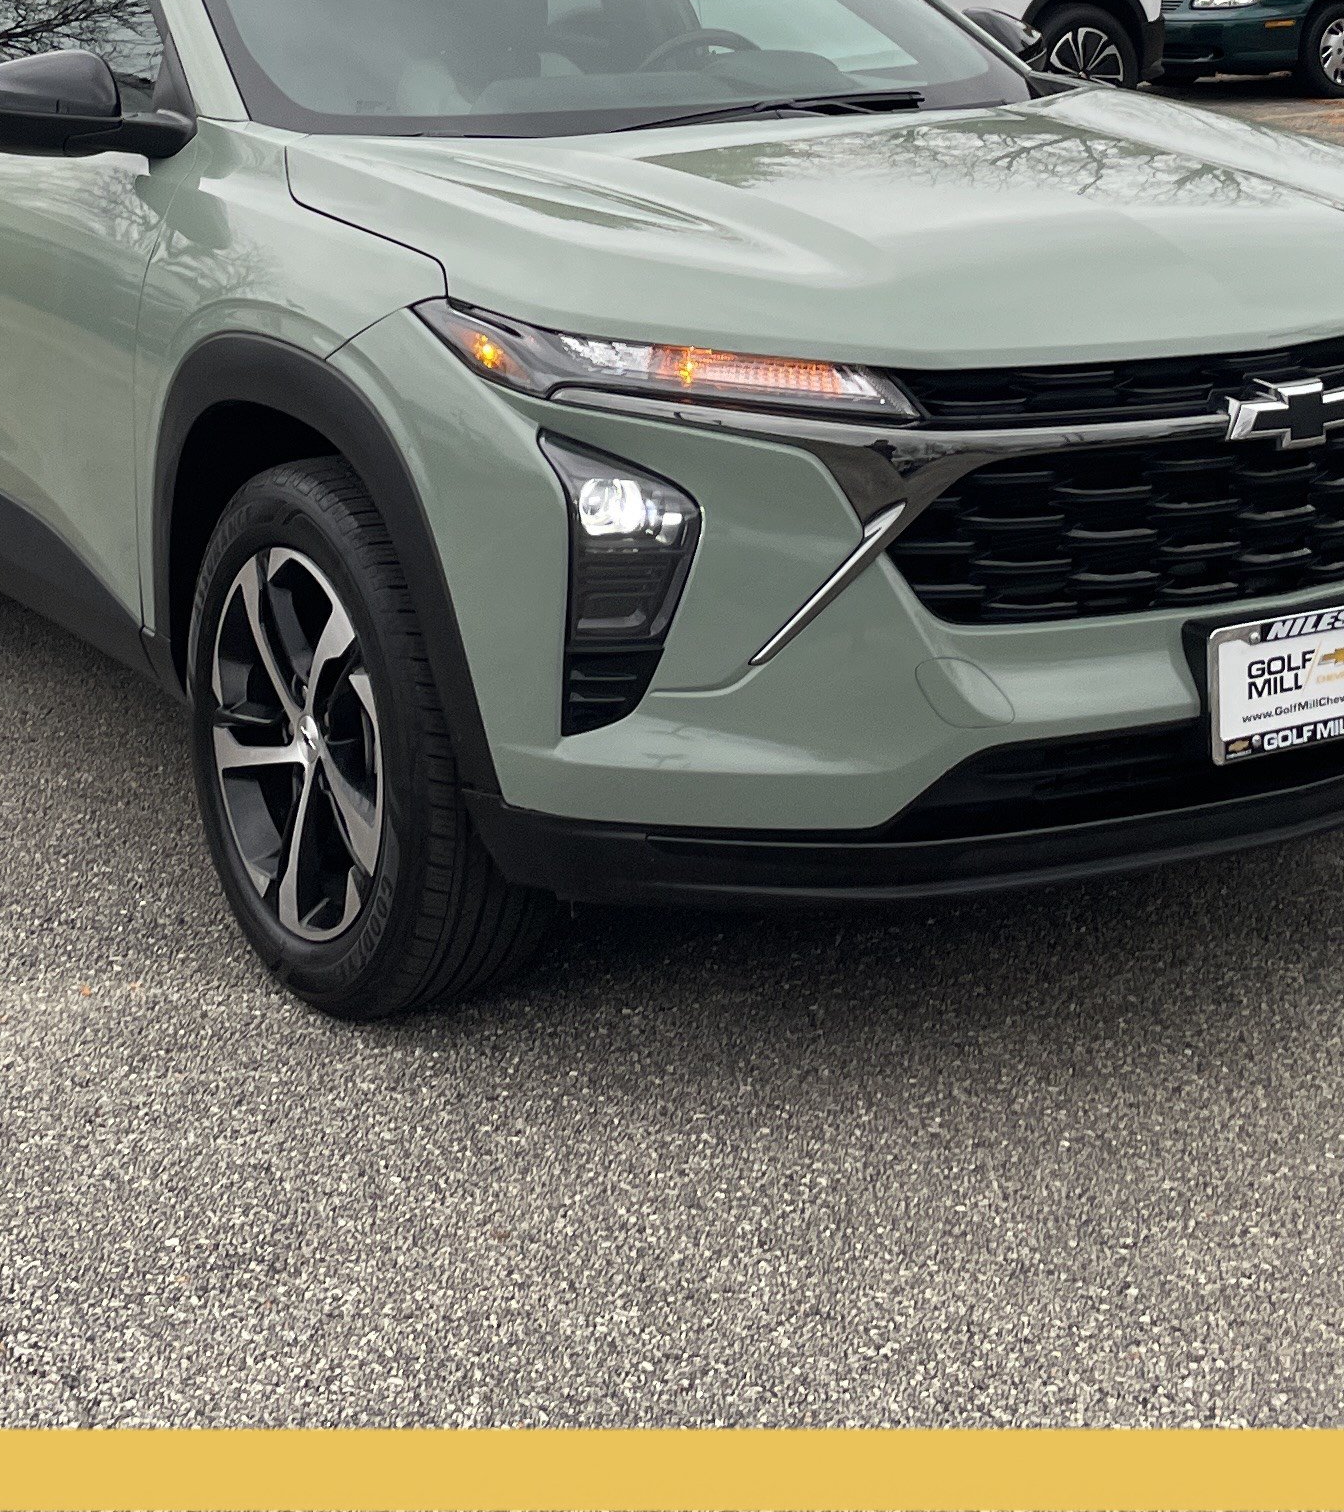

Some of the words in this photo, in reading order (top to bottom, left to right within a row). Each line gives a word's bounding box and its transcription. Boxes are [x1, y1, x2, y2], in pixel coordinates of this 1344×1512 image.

[1247, 648, 1316, 680] GOLF
[1247, 672, 1303, 700] MILL
[1263, 723, 1314, 752] GOLF
